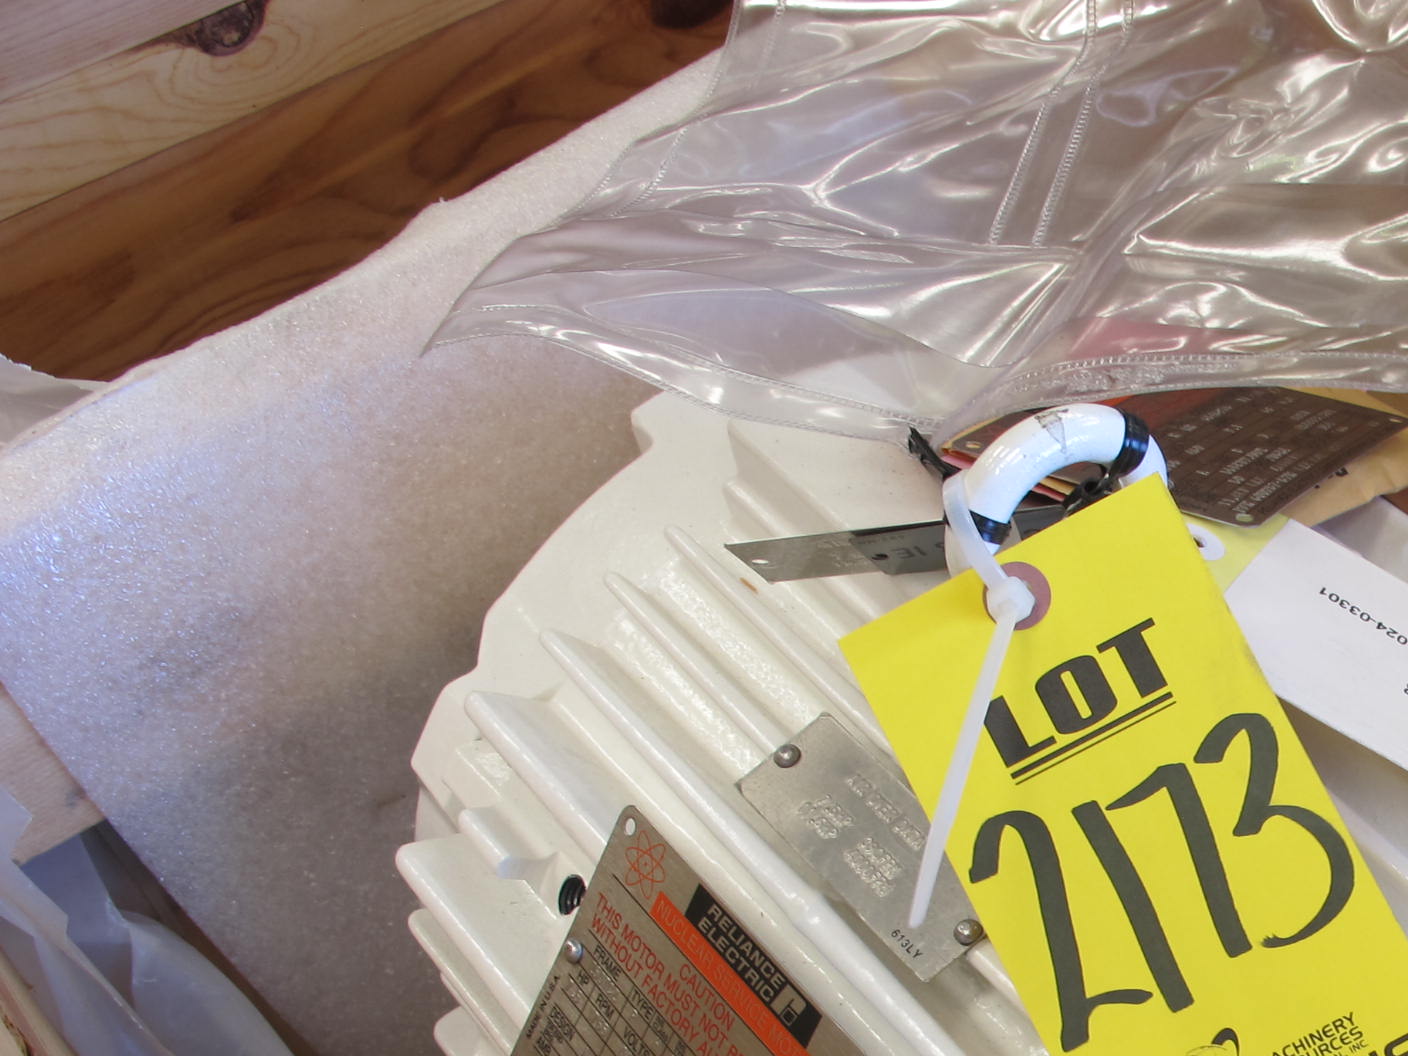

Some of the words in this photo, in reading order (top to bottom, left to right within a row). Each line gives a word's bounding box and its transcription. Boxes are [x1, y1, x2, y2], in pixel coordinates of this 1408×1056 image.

[1319, 587, 1408, 645] 024-03301
[983, 618, 1168, 768] LOT
[969, 713, 1355, 1052] 2173
[594, 892, 622, 931] THIS
[620, 922, 665, 980] MOTOR
[663, 972, 699, 1019] MUST
[698, 1012, 726, 1050] NOT
[655, 897, 714, 969] NUCLEAR
[698, 914, 773, 1003] ELECTRIC
[707, 902, 783, 991] RELIANCE
[890, 929, 923, 959] 613LY
[576, 971, 588, 988] HP
[595, 994, 613, 1020] RPM
[590, 914, 642, 980] WITHOUT
[641, 973, 699, 1045] FACTORY
[593, 944, 620, 981] FRAME
[631, 990, 653, 1019] TYPE
[678, 962, 735, 1032] CAUTION
